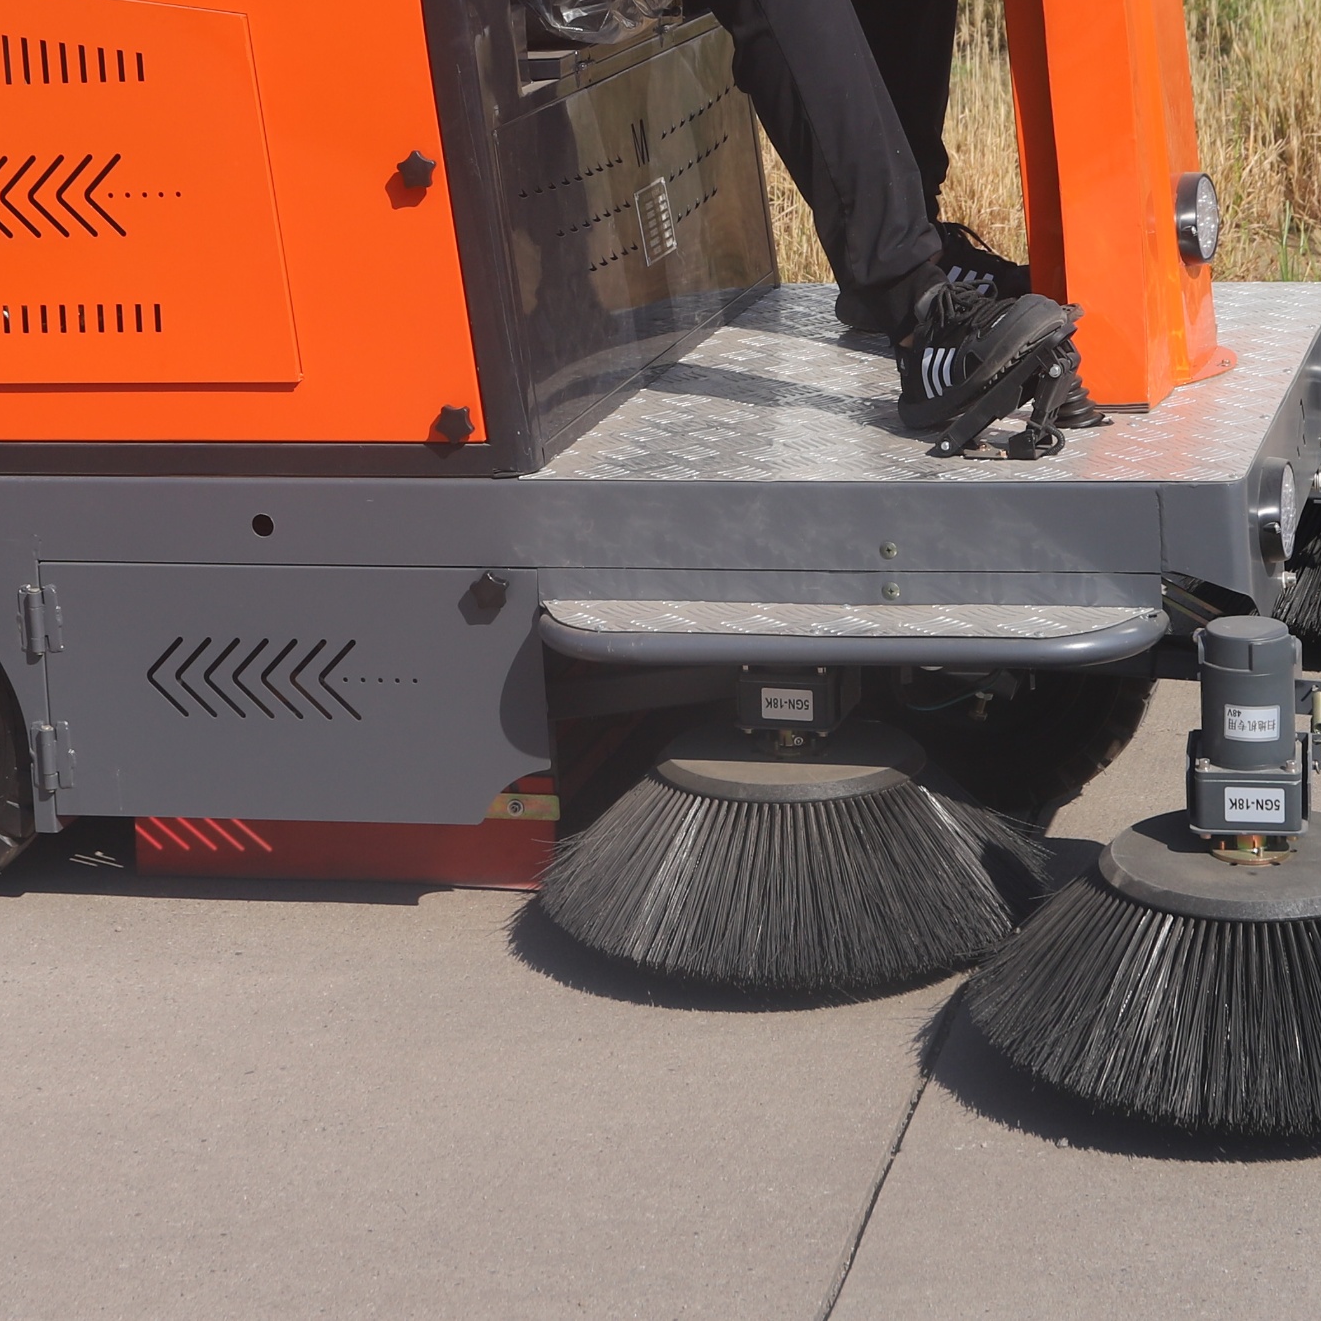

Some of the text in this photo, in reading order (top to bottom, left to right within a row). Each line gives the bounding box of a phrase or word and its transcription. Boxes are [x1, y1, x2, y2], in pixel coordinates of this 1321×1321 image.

[765, 697, 809, 711] 5GN-18K
[1227, 708, 1242, 718] 48V
[1228, 718, 1276, 732] 扫地机专用
[1228, 798, 1280, 811] 5GN-18K
